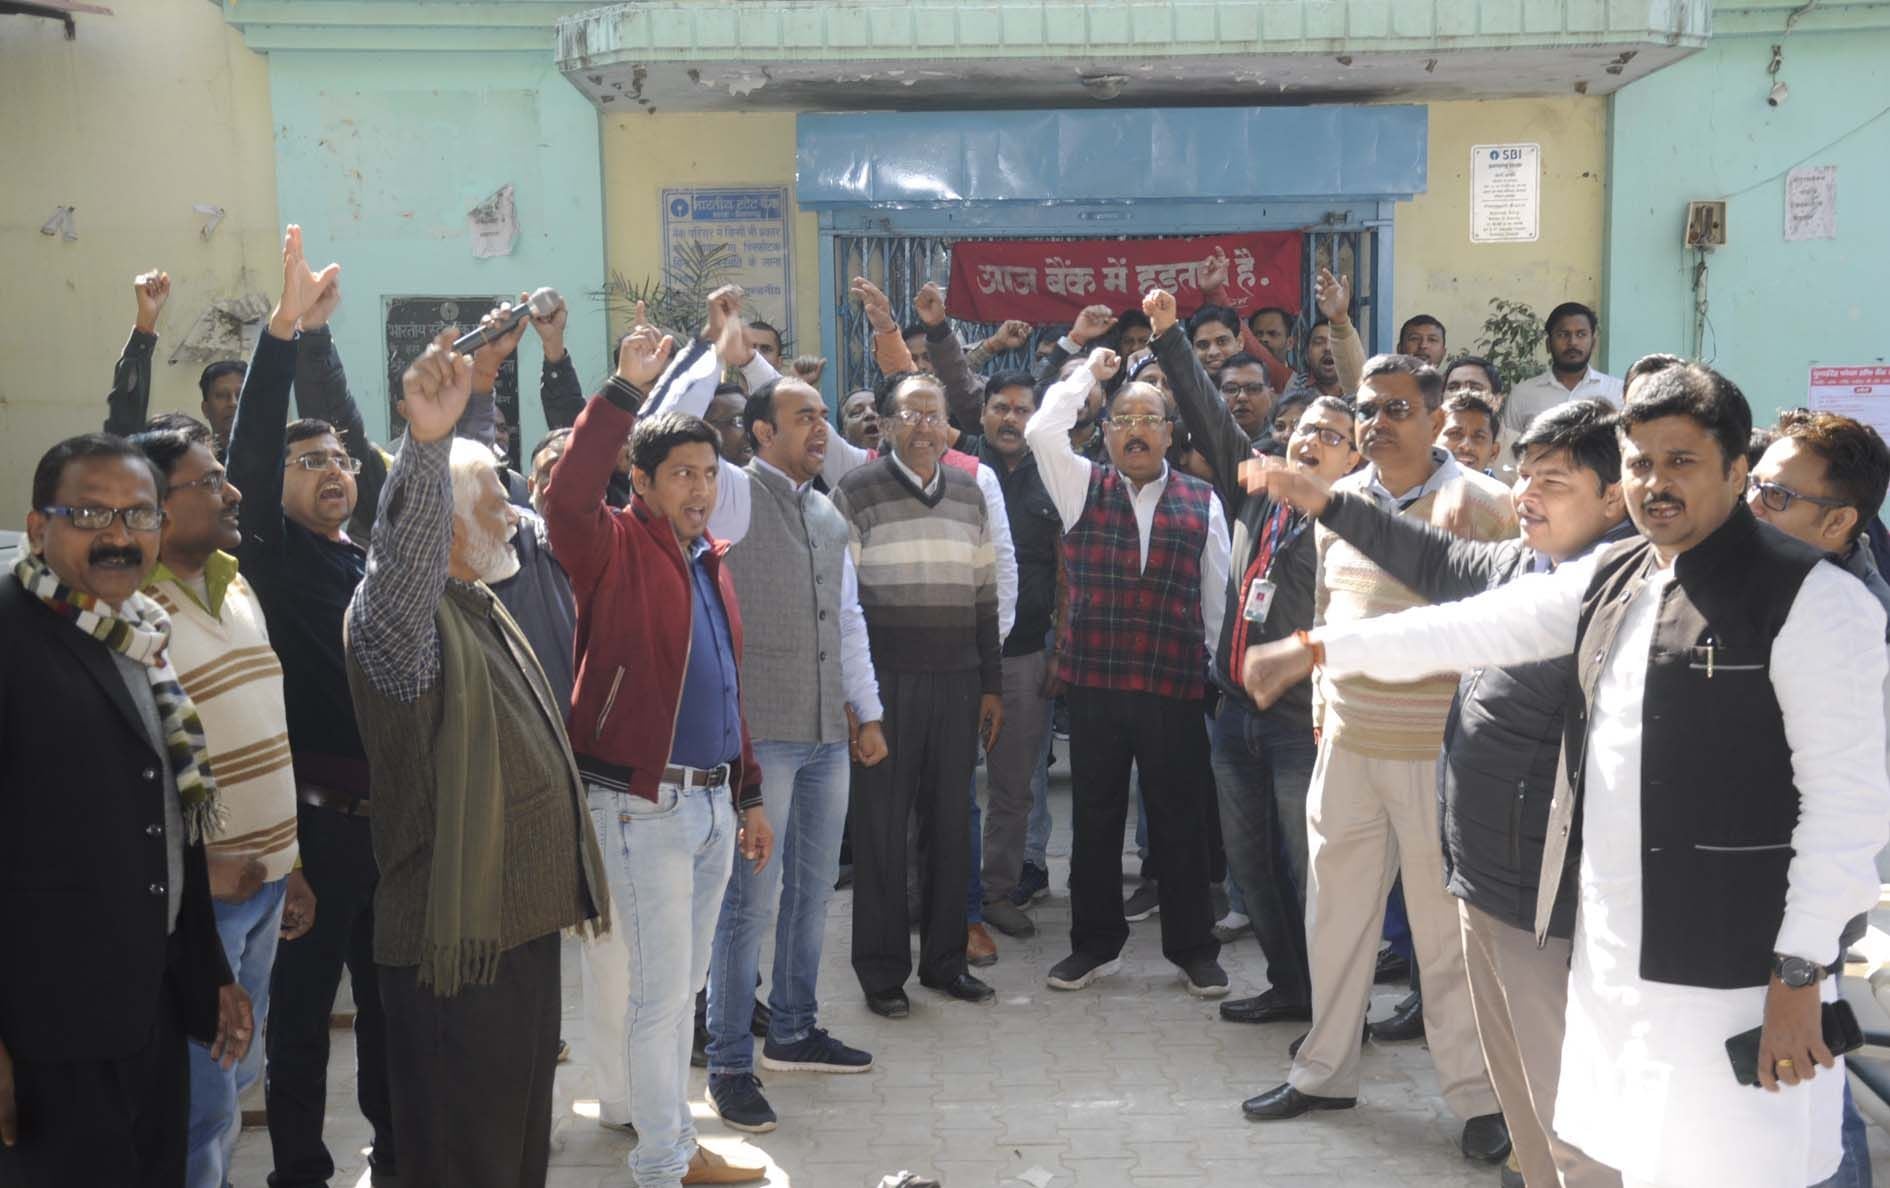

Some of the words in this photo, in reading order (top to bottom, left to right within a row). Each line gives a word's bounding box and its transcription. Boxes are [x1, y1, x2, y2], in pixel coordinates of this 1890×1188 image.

[1502, 149, 1522, 160] SBI
[977, 264, 1037, 295] आज
[1044, 257, 1096, 296] बैंक
[1102, 257, 1128, 294] में
